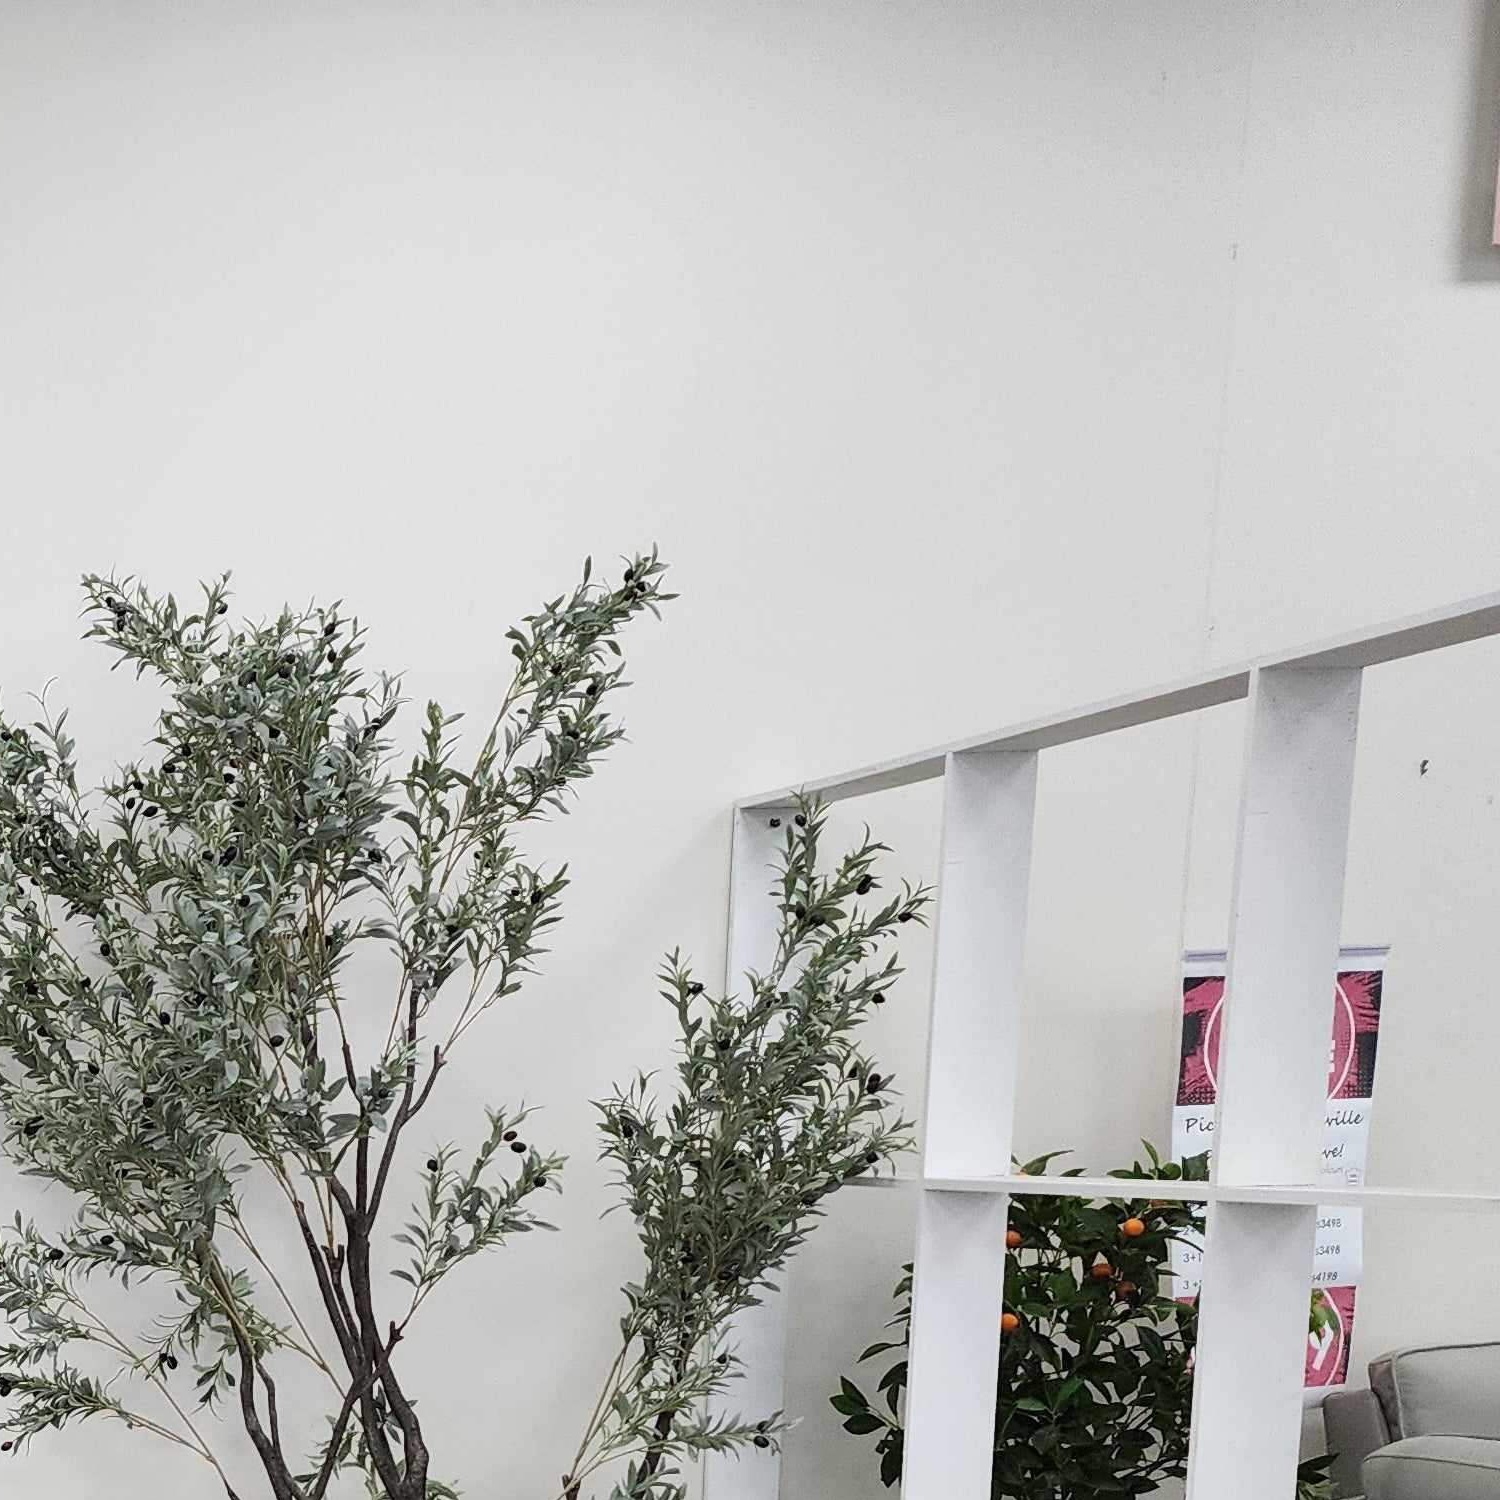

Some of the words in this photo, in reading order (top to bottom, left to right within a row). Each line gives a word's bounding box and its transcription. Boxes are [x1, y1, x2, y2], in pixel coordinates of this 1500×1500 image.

[1185, 1116, 1215, 1134] Pic
[1324, 1110, 1364, 1127] ville
[1322, 1143, 1345, 1159] ve!
